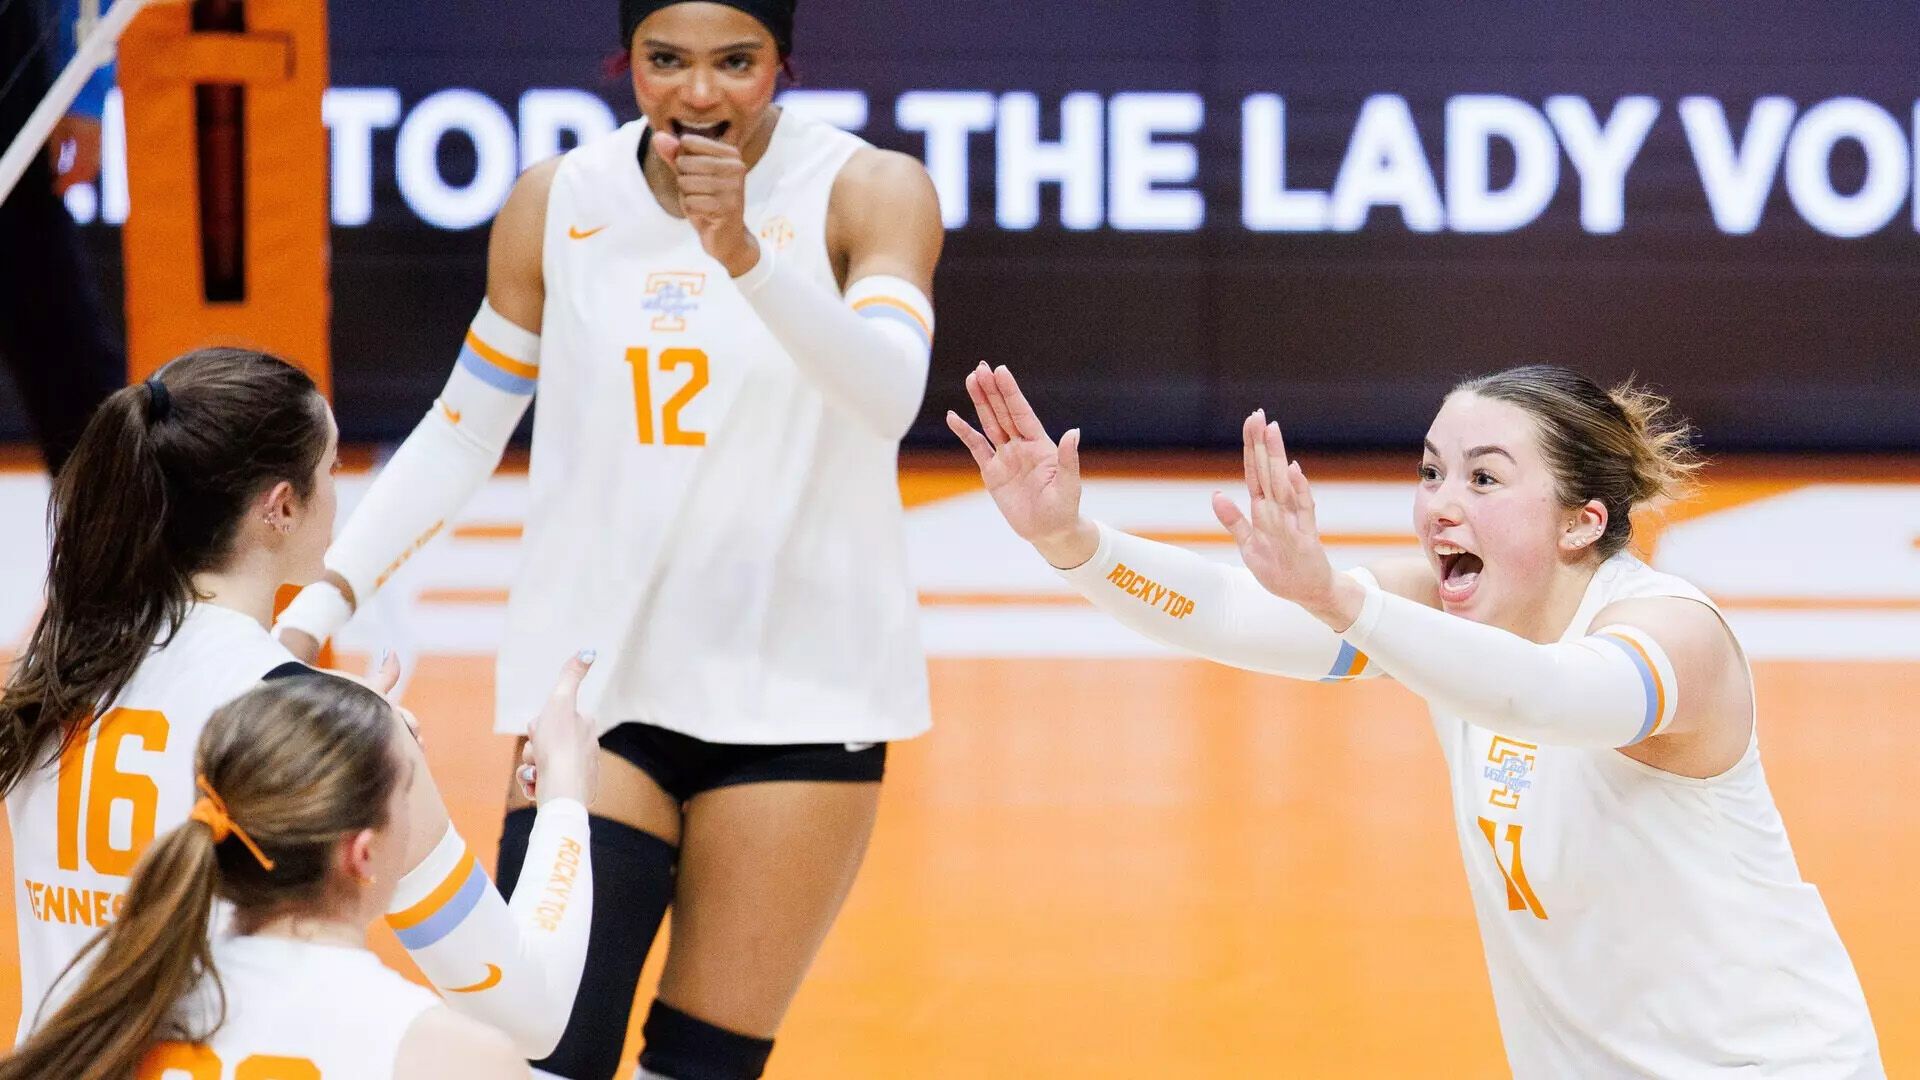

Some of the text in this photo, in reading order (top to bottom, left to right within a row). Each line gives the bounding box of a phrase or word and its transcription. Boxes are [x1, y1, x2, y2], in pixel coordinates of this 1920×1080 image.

[896, 89, 1205, 231] THE
[1241, 93, 1661, 234] LADY
[1677, 95, 1920, 238] VO
[624, 346, 710, 446] 12
[1106, 562, 1196, 619] ROCKY TOP
[56, 703, 170, 878] 16
[545, 836, 582, 901] ROCKY
[1477, 815, 1549, 920] 11
